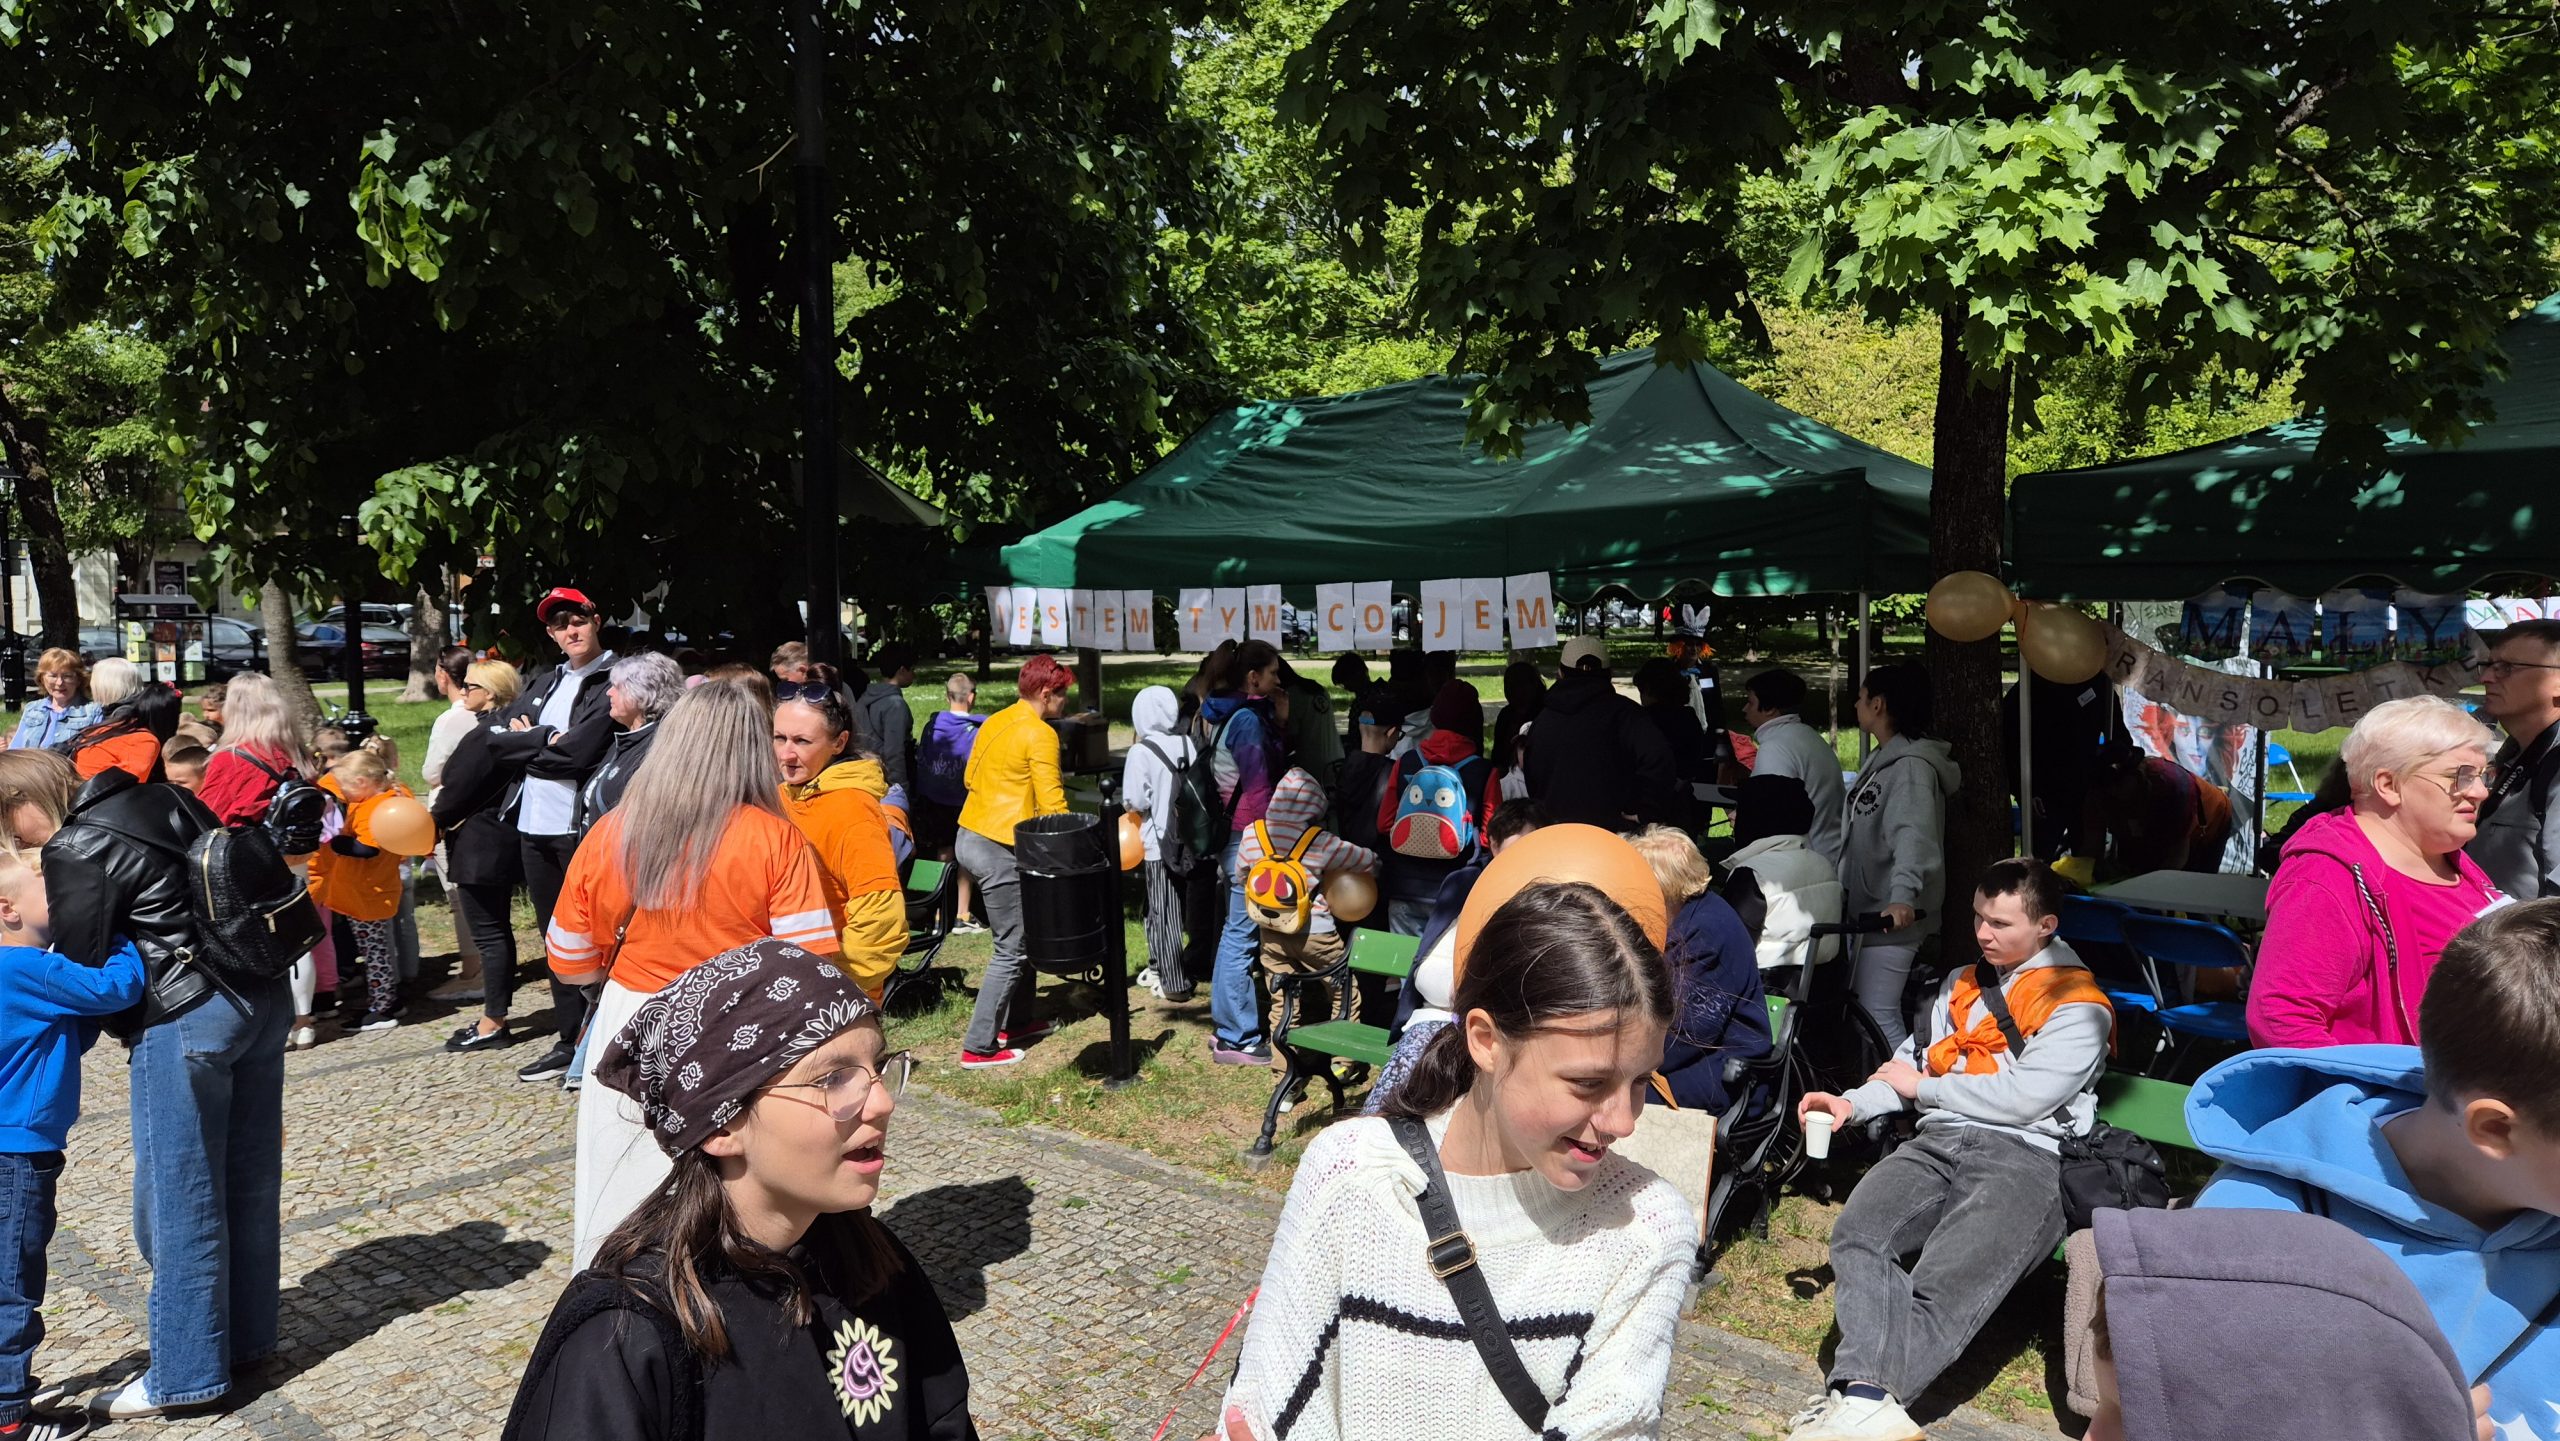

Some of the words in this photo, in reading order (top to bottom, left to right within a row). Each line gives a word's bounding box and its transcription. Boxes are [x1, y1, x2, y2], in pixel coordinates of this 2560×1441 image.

[998, 606, 1148, 633] JESTEM
[1188, 604, 1276, 632] TYM
[1328, 603, 1385, 632] CO
[1434, 596, 1547, 638] JEM
[2498, 765, 2524, 796] Canon
